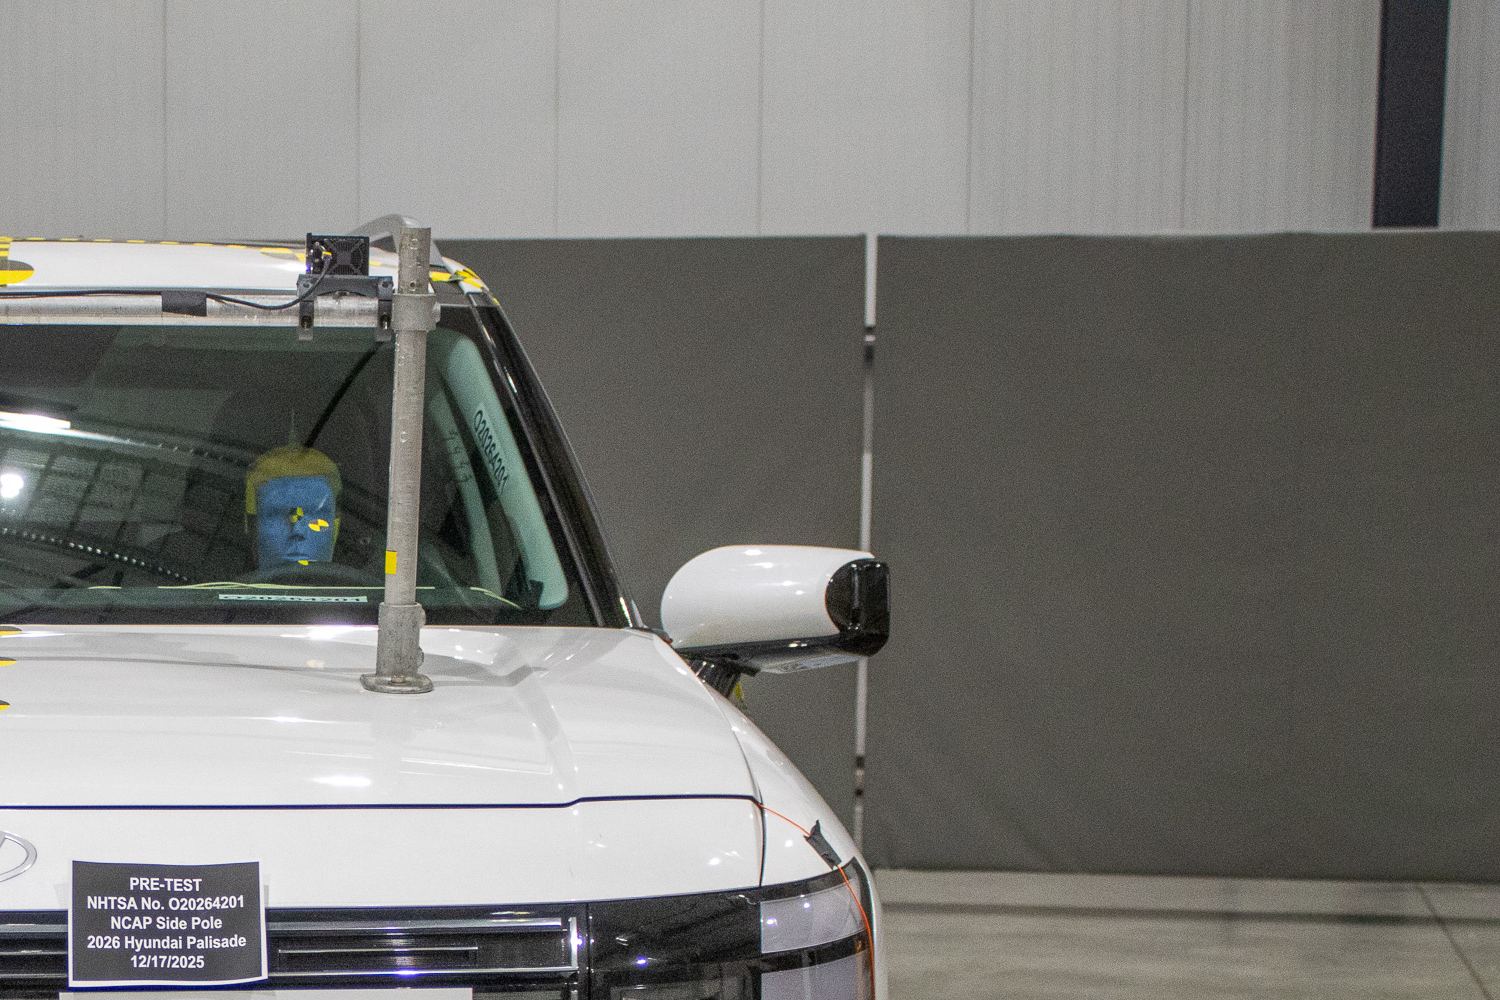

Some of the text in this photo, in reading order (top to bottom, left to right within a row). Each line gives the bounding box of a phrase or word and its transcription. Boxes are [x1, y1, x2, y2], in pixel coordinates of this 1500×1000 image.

[129, 877, 203, 892] PRE-TEST
[87, 895, 244, 911] NHTSA No. O20264201
[110, 916, 223, 930] NCAP Side Pole
[87, 934, 247, 952] 2026 Hyundai Palisade
[130, 955, 205, 969] 12/17/2025
